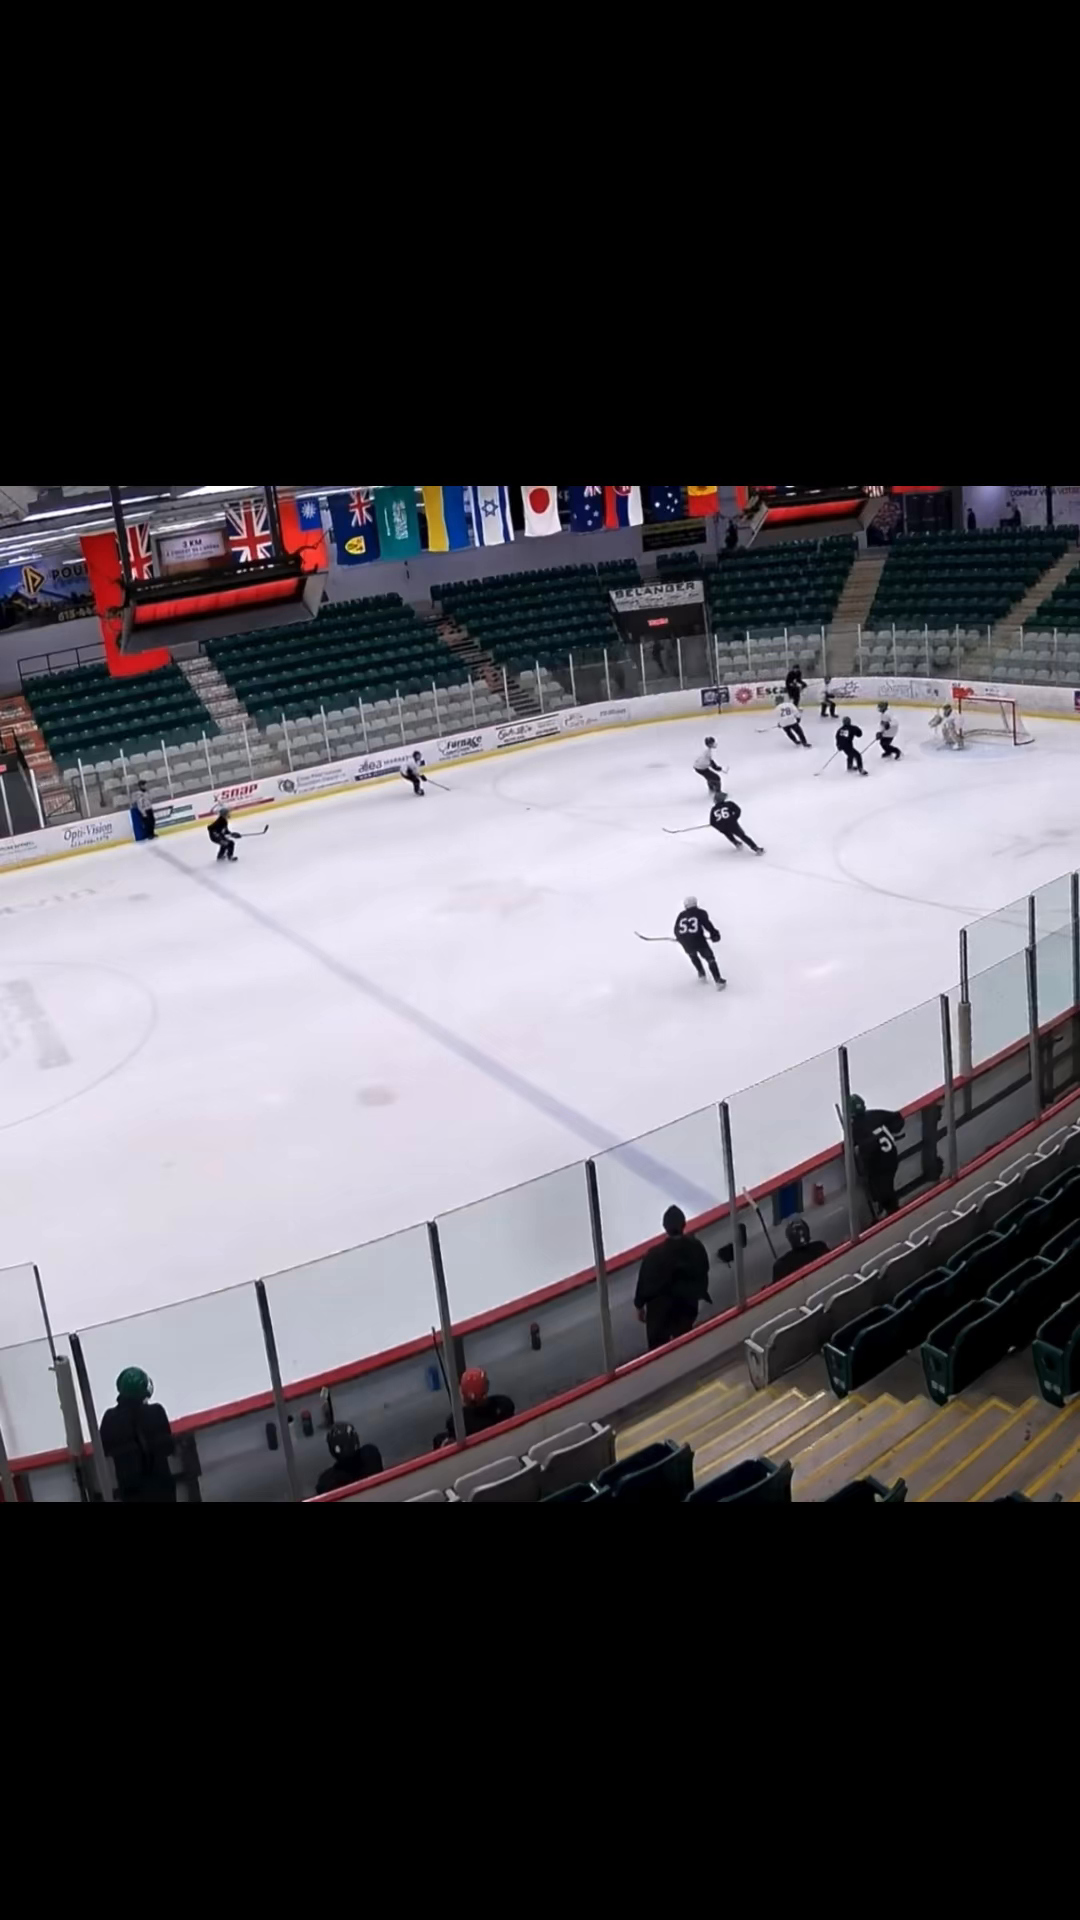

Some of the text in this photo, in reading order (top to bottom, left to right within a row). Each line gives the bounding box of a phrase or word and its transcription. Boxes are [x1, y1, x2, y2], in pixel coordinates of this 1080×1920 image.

[615, 582, 695, 599] BELANGER
[713, 806, 731, 822] 56
[63, 822, 113, 843] Opti-Vision
[679, 916, 699, 934] 53
